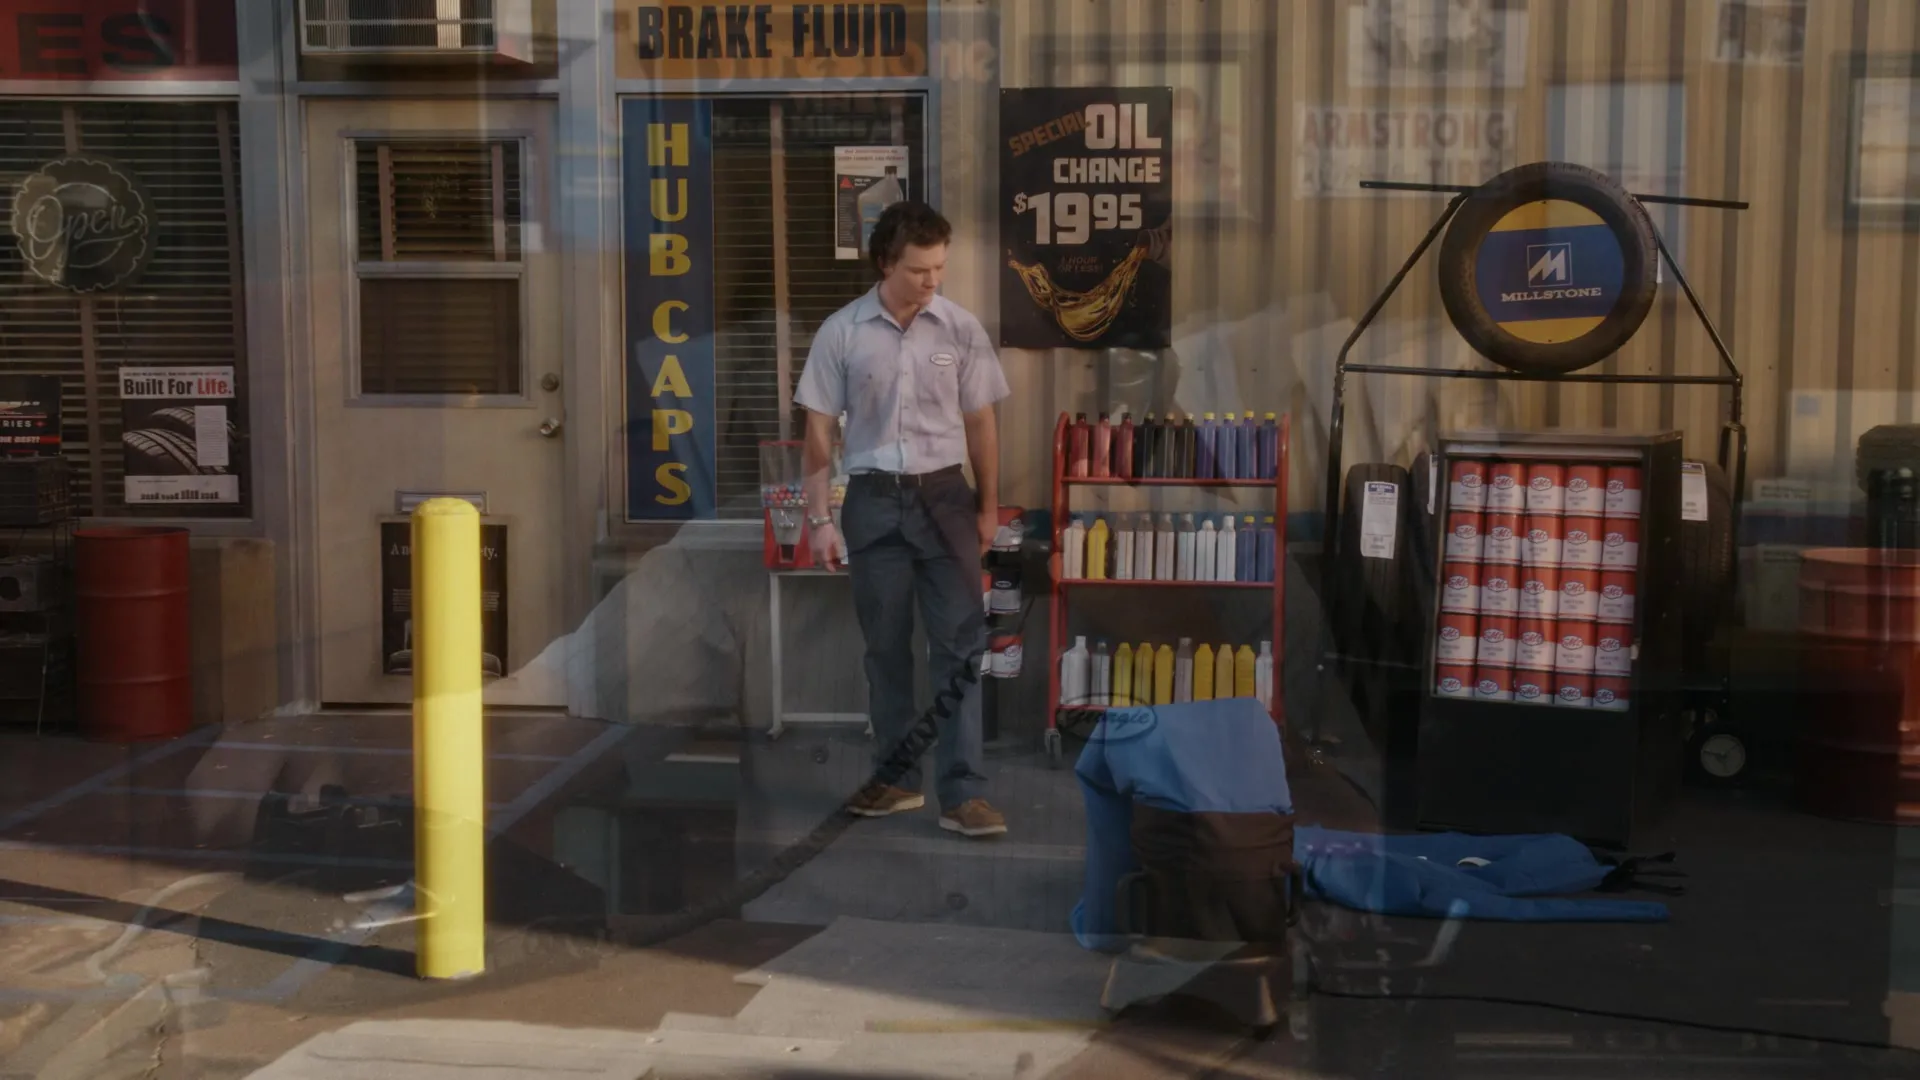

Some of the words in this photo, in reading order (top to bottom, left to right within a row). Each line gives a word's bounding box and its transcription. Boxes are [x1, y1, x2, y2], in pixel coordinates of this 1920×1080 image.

[2, 12, 175, 74] ES
[638, 5, 772, 60] BRAKE
[793, 3, 907, 58] FLUID
[1009, 111, 1092, 158] SPECIAL
[1084, 103, 1162, 149] OIL
[1053, 156, 1161, 184] CHANGE
[26, 194, 142, 278] Open
[1500, 287, 1602, 302] MILLSTONE
[124, 378, 164, 395] Built
[168, 378, 193, 395] For
[197, 377, 232, 395] Life.
